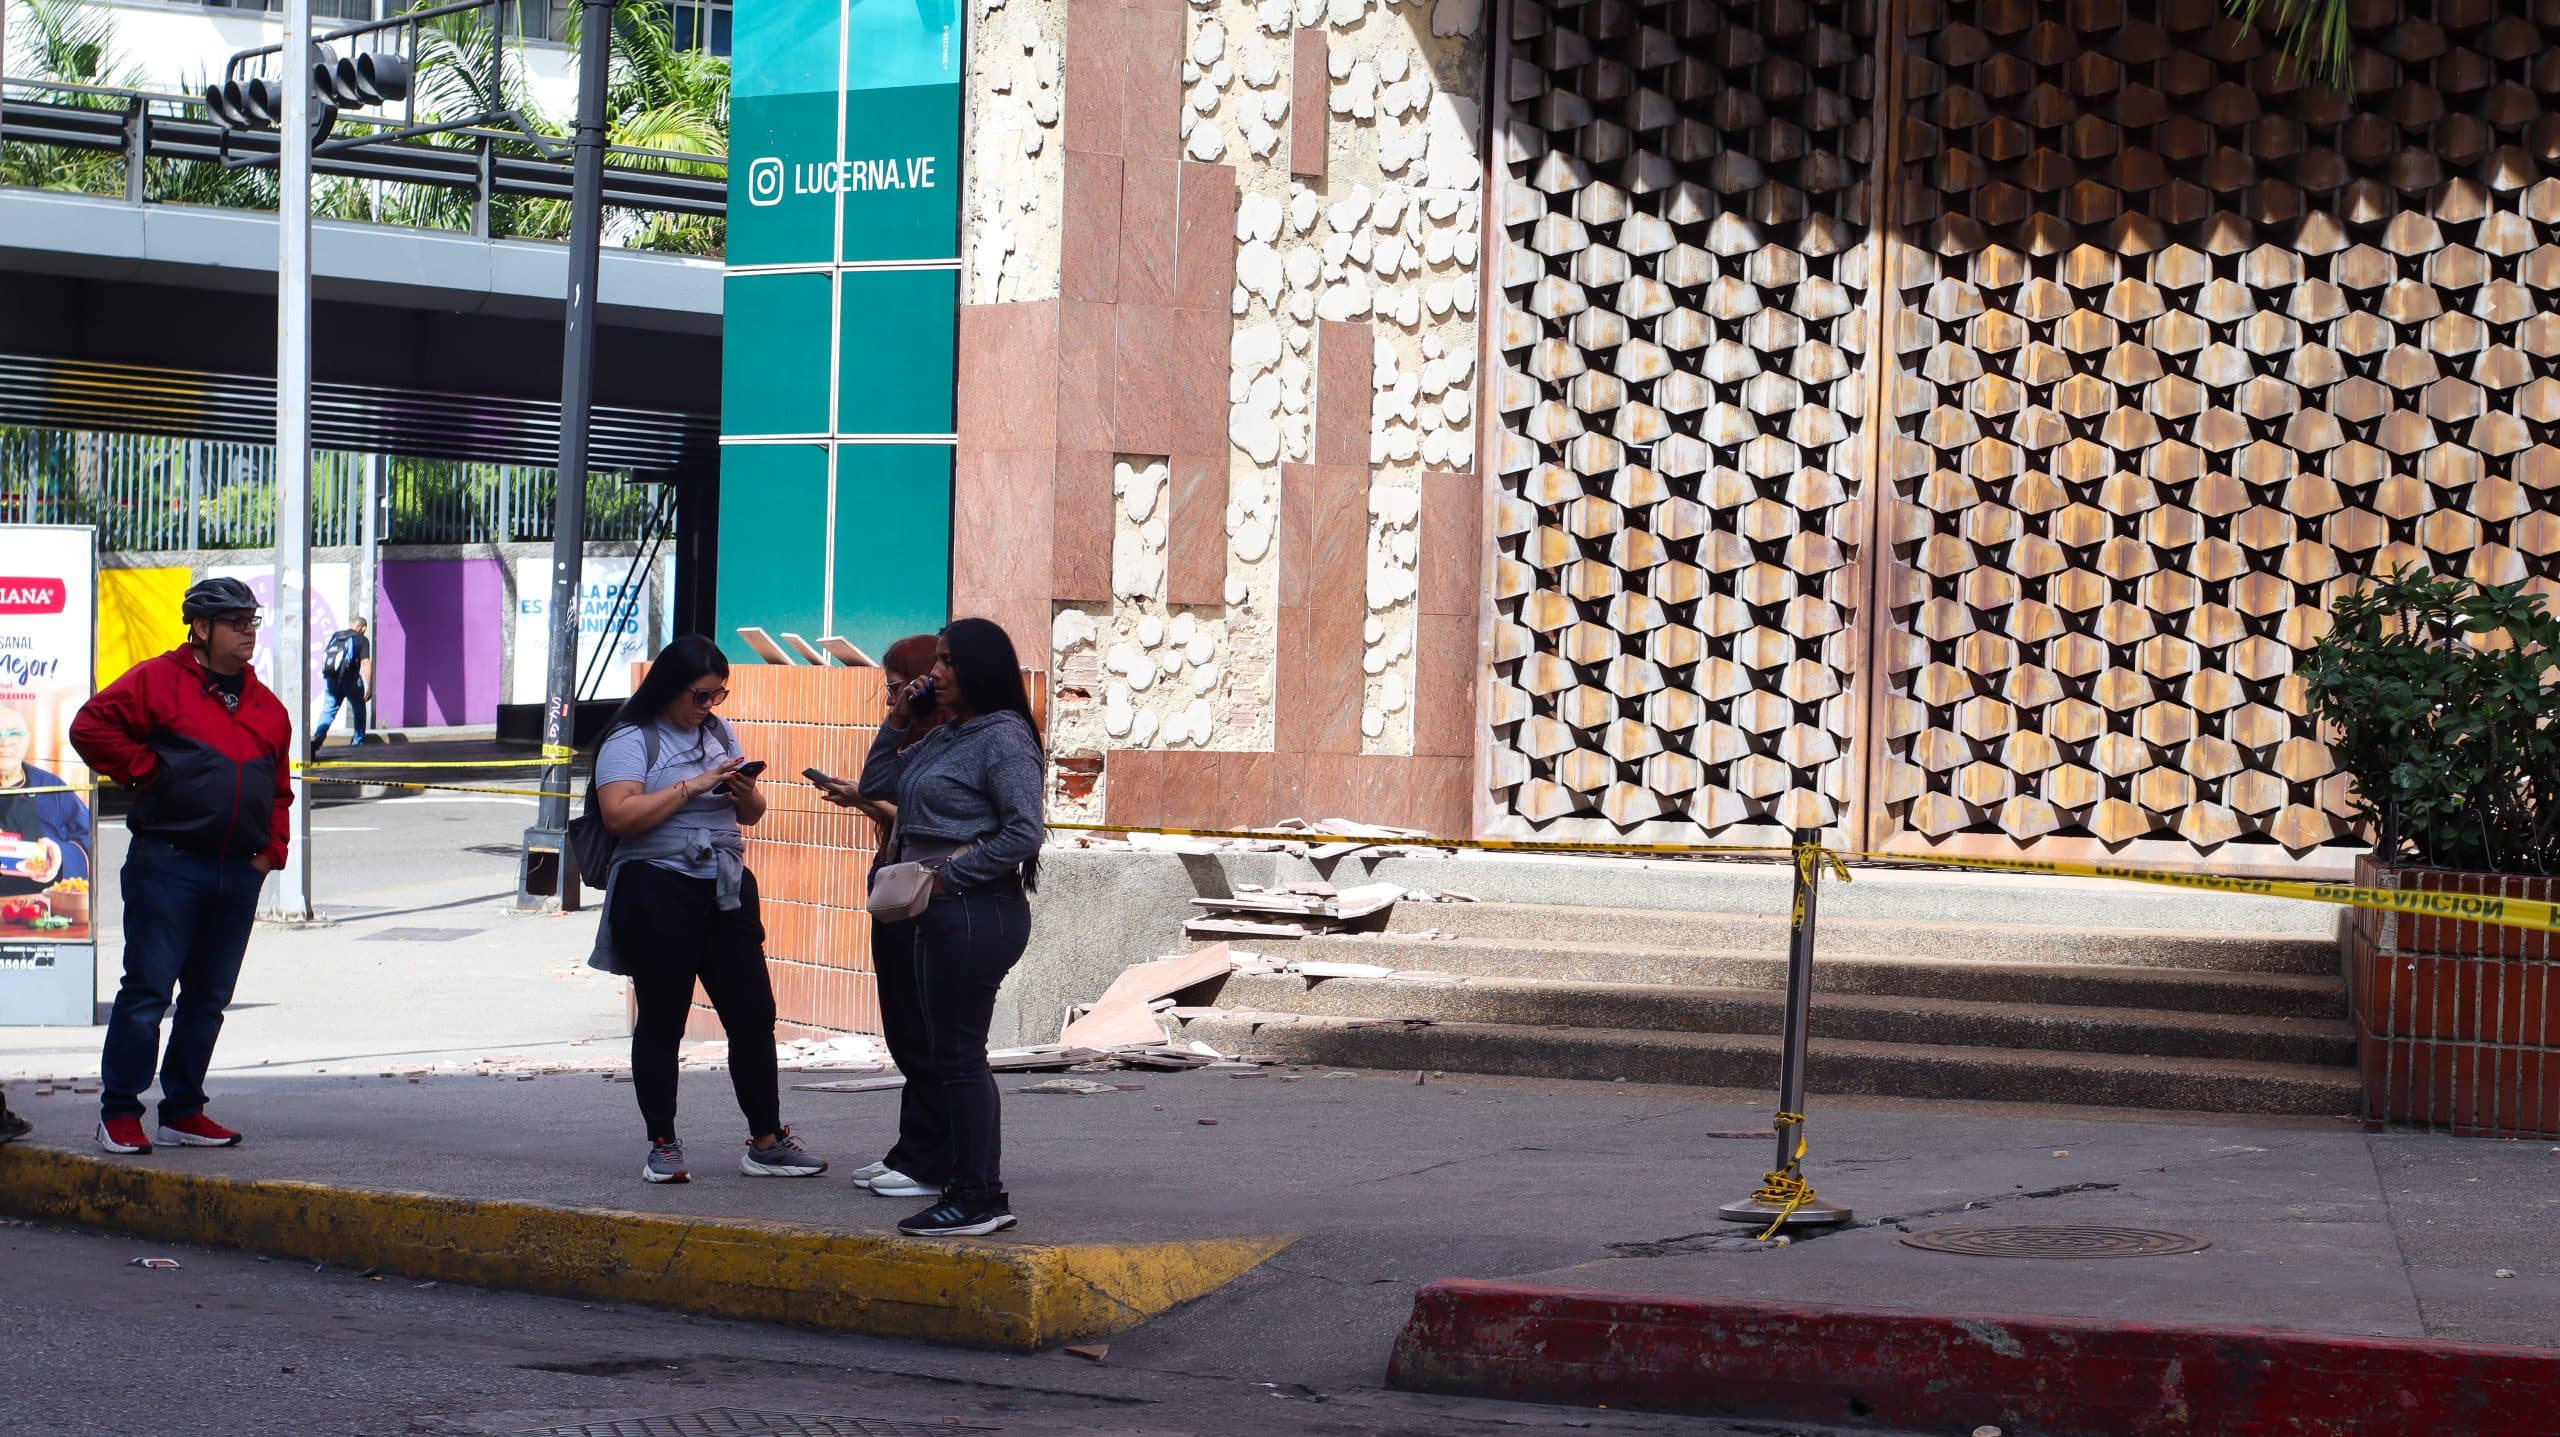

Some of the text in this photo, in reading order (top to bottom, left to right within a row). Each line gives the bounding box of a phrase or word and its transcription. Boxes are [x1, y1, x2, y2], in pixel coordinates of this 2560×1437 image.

[795, 156, 936, 194] LUCERNA.VE
[580, 584, 639, 600] LA PAZ
[521, 599, 543, 614] ES
